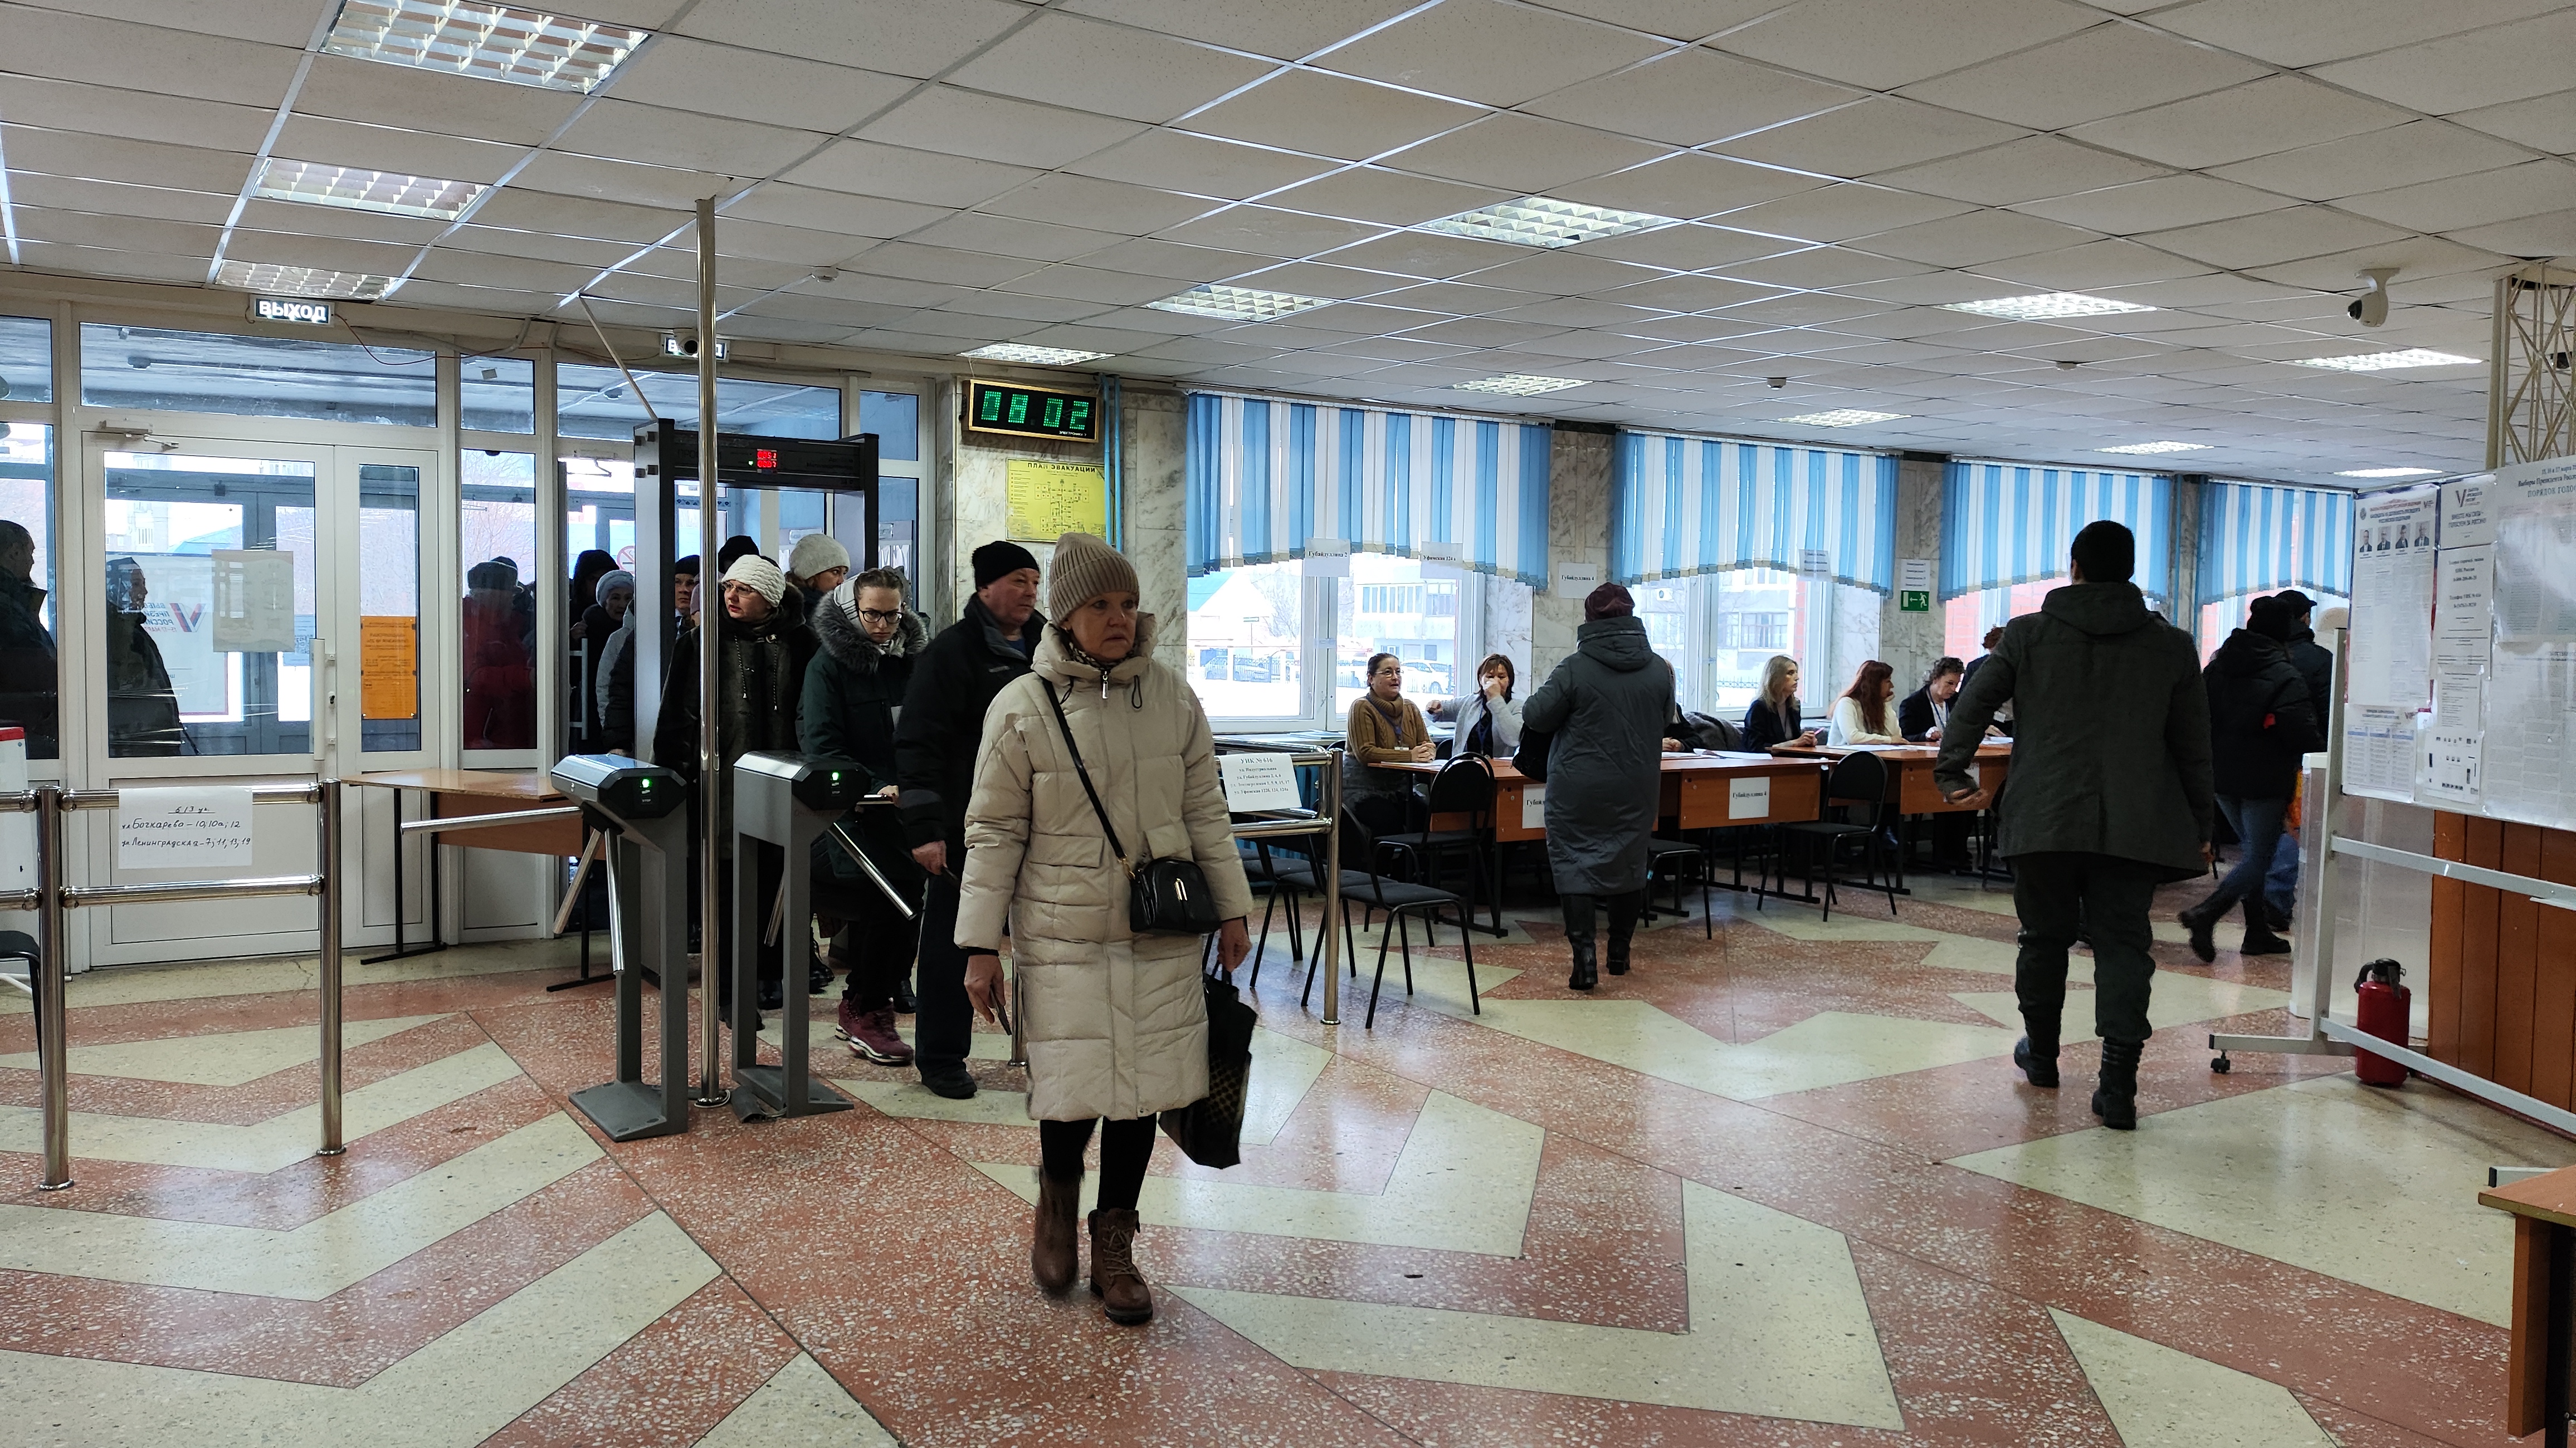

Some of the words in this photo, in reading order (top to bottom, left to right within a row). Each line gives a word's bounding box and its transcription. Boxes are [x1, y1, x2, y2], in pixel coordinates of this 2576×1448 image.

[259, 301, 326, 322] ВЫХОД
[1051, 464, 1095, 473] ЭВАКУАЦИИ
[2528, 487, 2556, 497] ПОРЯДОК
[241, 837, 251, 845] 19
